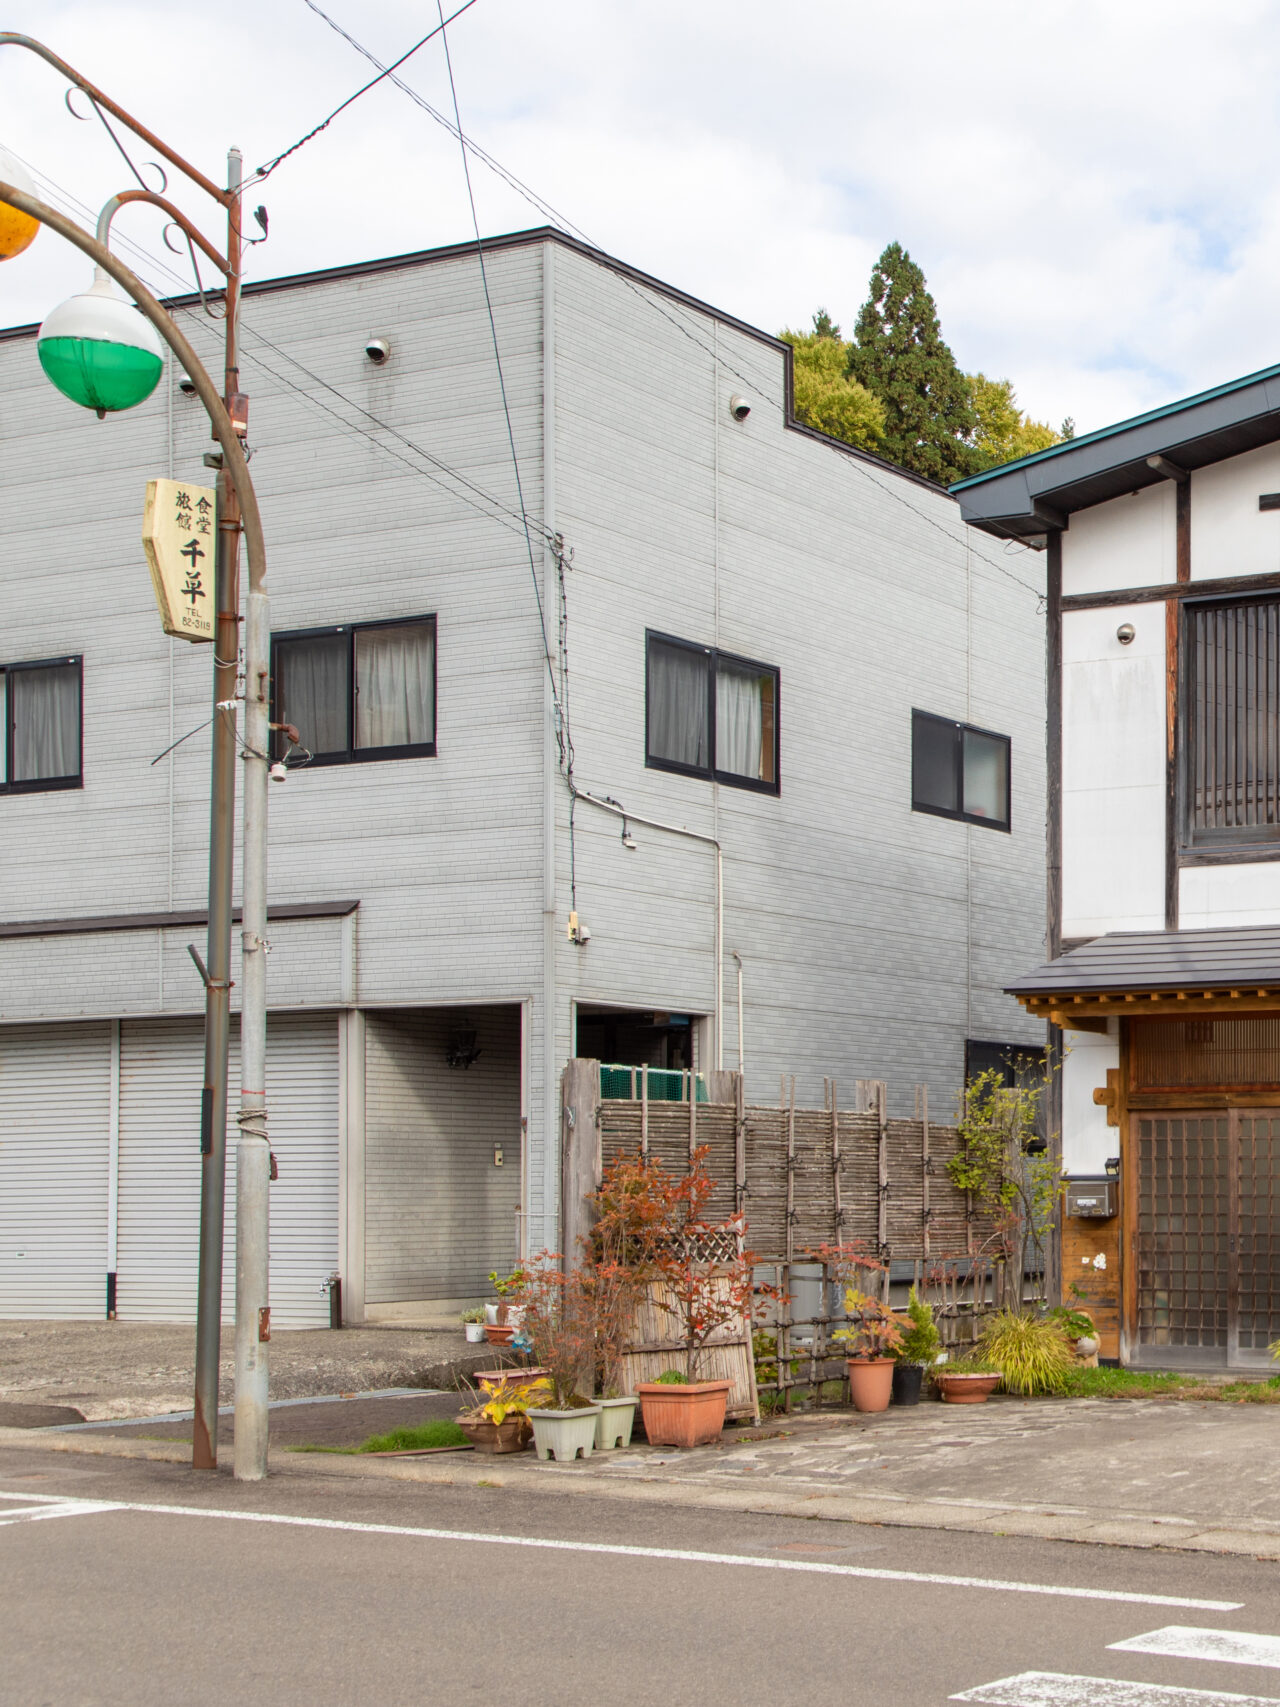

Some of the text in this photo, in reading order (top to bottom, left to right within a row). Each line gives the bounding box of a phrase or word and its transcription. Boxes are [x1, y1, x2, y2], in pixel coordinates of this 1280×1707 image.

[195, 496, 213, 535] 食堂
[180, 538, 206, 604] 千草
[185, 606, 202, 618] TEL
